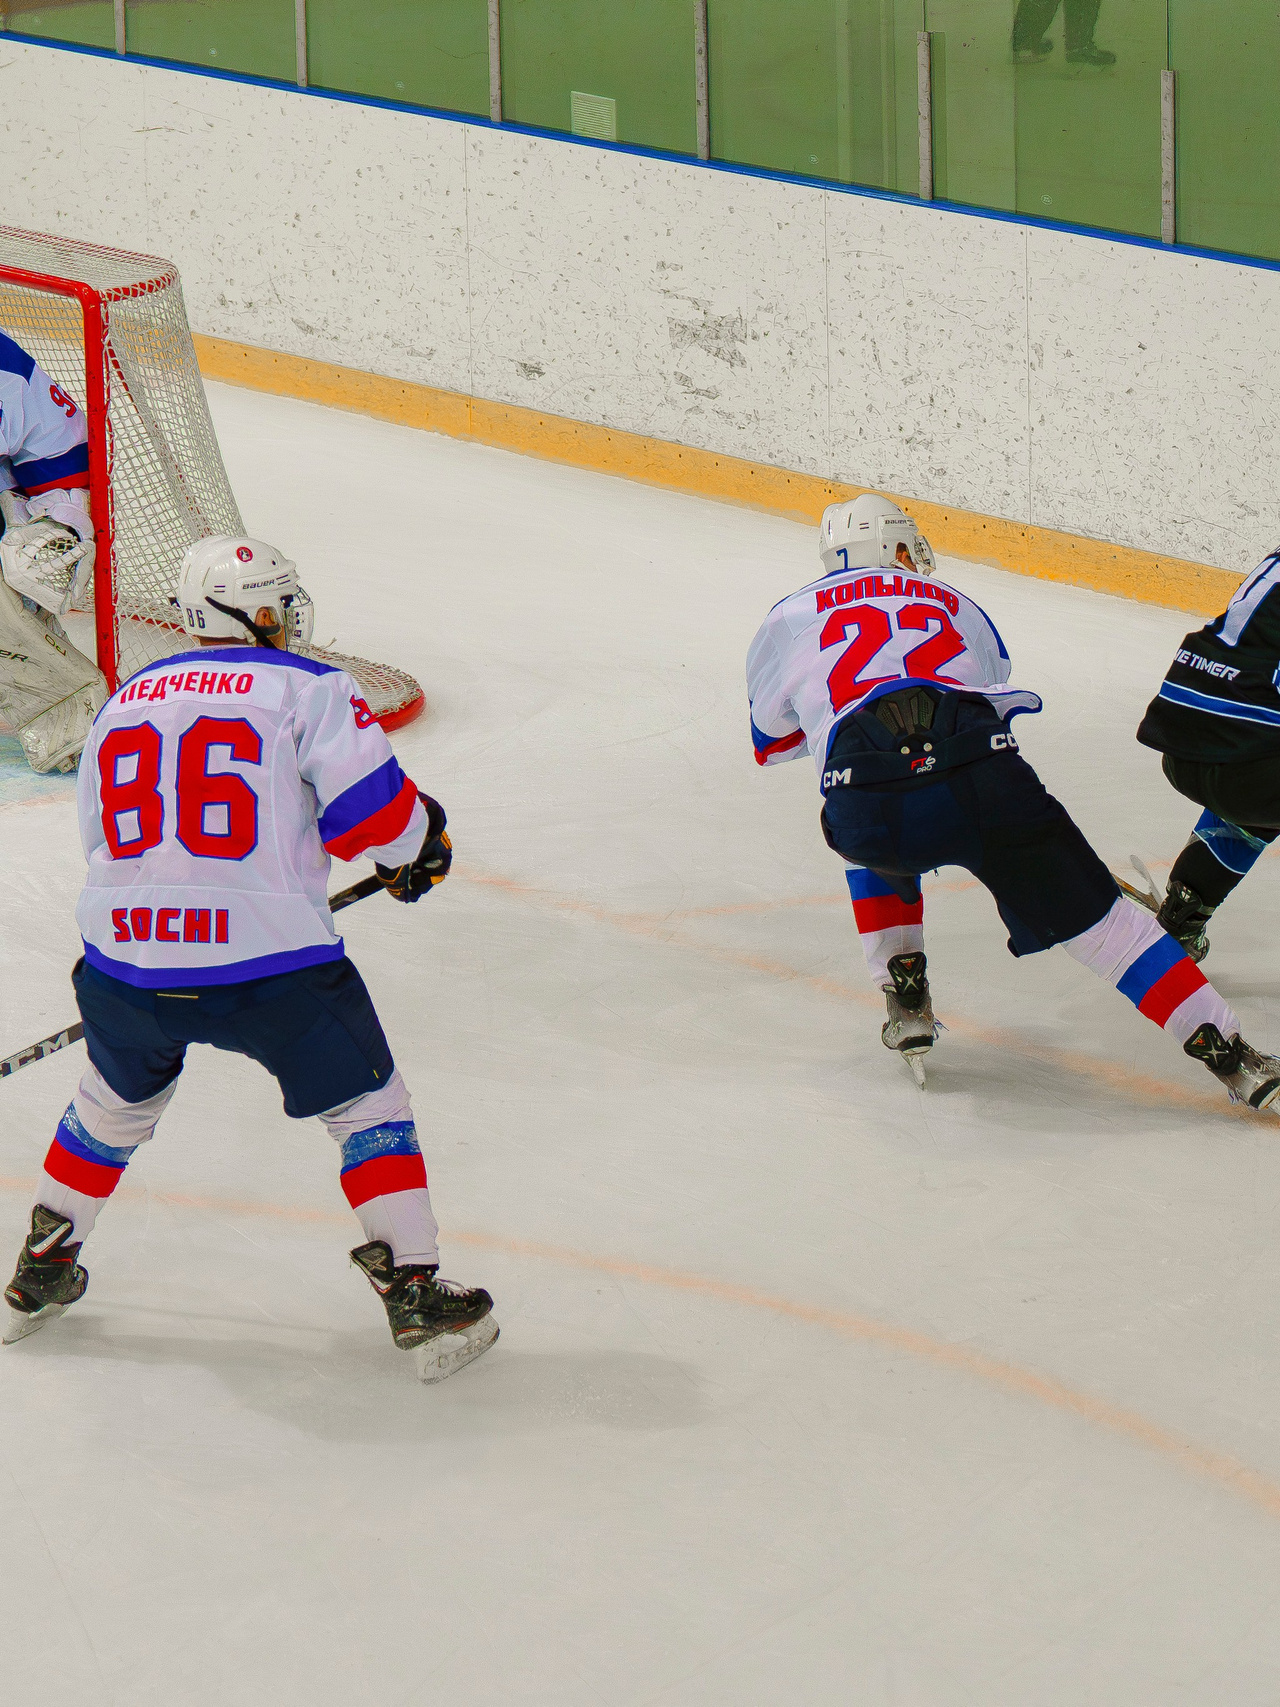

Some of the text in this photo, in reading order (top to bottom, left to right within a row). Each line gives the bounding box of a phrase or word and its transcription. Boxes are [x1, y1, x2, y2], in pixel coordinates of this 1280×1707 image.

[242, 579, 275, 590] BAUER
[815, 575, 960, 617] КОПЫЛОВ
[186, 608, 206, 629] 86
[819, 603, 967, 717] 22
[823, 768, 852, 788] CM
[911, 755, 936, 771] FT6
[97, 715, 263, 862] 86
[111, 908, 229, 944] SOCHI
[0, 1030, 70, 1078] CM
